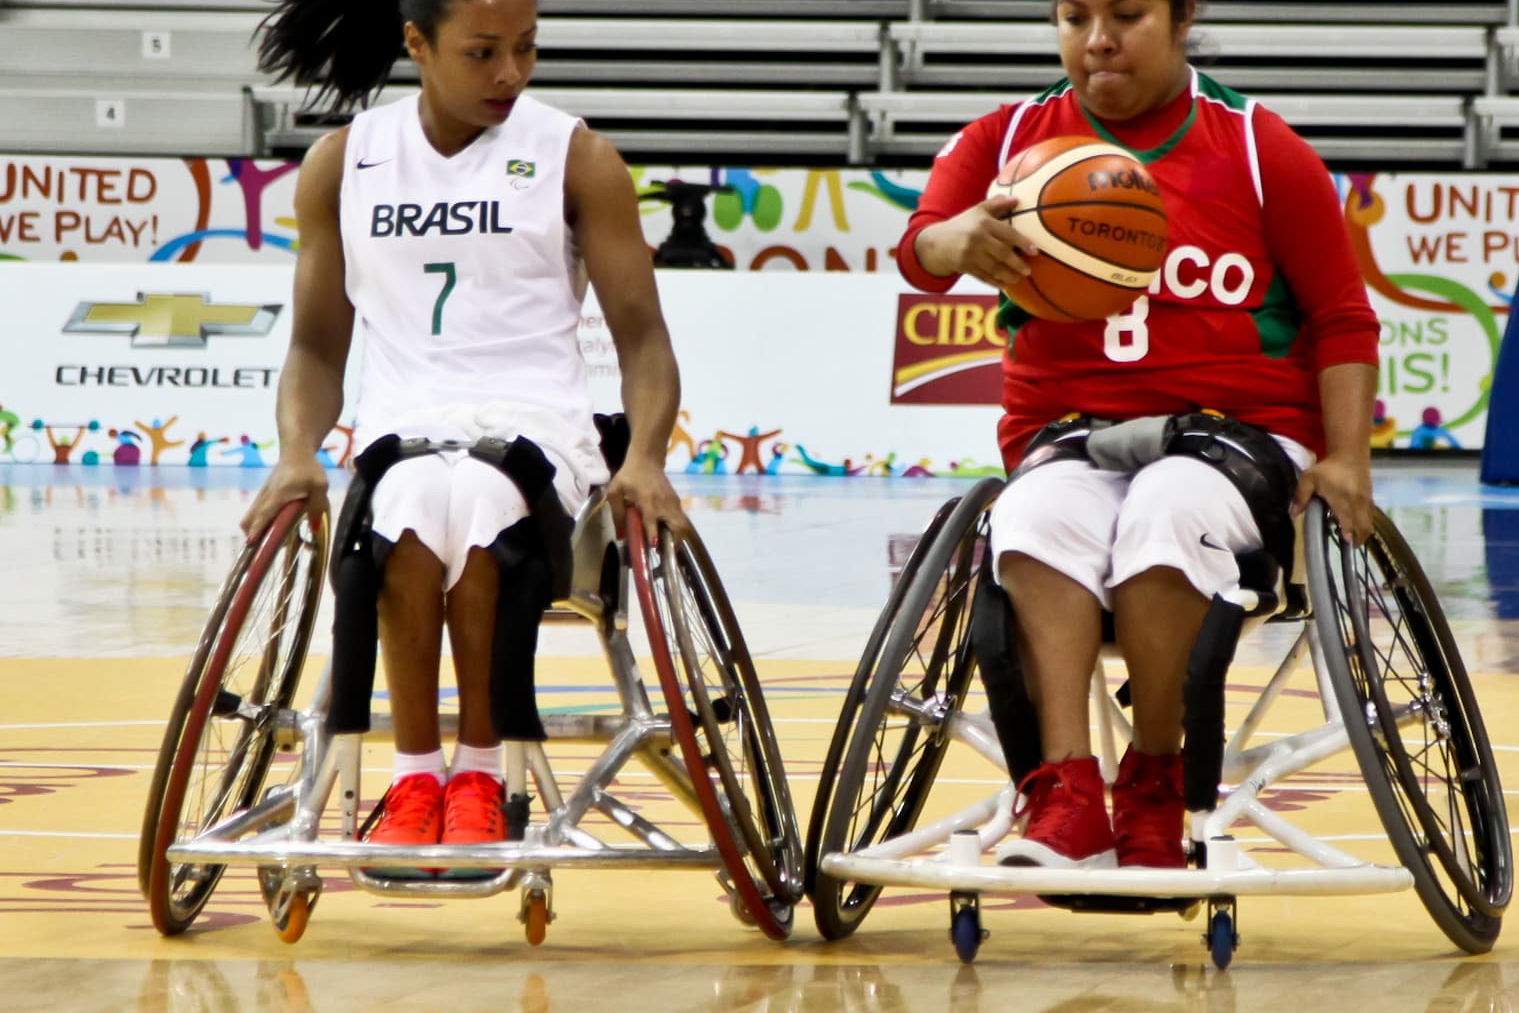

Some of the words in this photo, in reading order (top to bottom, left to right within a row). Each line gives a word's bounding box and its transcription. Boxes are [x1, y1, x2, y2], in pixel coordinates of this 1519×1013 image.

[55, 210, 159, 247] PLAY!
[370, 200, 514, 238] BRASIL
[1407, 232, 1468, 265] WE
[423, 261, 457, 336] 7
[1103, 294, 1149, 363] 8
[55, 365, 279, 388] CHEVROLET
